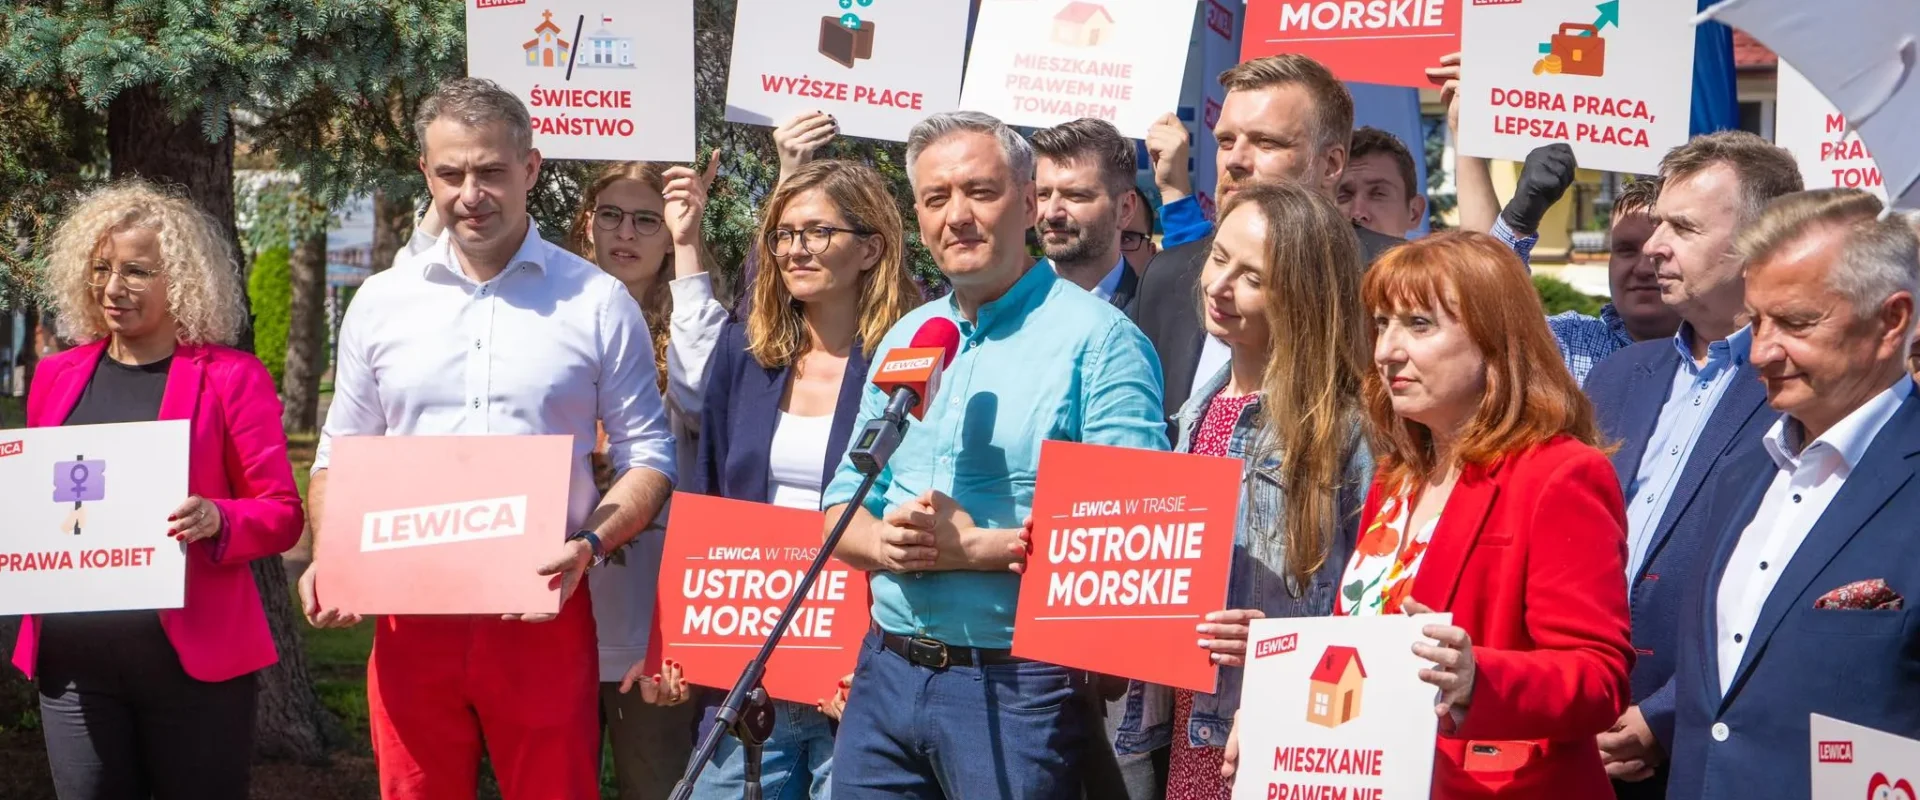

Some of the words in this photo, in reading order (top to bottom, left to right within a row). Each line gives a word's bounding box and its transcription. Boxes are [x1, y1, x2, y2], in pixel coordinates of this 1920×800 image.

[1279, 0, 1446, 31] MORSKIE
[1013, 52, 1133, 79] MIESZKANIE
[530, 84, 632, 109] ŚWIECKIE
[761, 74, 848, 101] WYŻSZE
[853, 85, 923, 110] PŁACE
[1005, 73, 1095, 97] PRAWEM
[1099, 84, 1133, 101] NIE
[1012, 95, 1117, 121] TOWAREM
[1490, 87, 1567, 113] DOBRA
[1572, 95, 1656, 124] PRACA,
[529, 113, 635, 137] PAŃSTWO
[1494, 115, 1570, 140] LEPSZA
[1576, 124, 1650, 148] PŁACA
[886, 359, 929, 370] LEWICA
[1071, 500, 1122, 518] LEWICA
[1124, 499, 1140, 514] W
[1143, 496, 1186, 514] TRASIE
[372, 503, 517, 544] LEWICA
[708, 547, 761, 561] LEWICA
[765, 548, 781, 560] W
[783, 547, 823, 561] TRAS
[1048, 522, 1205, 564] USTRONIE
[0, 550, 74, 572] PRAWA
[79, 547, 156, 569] KOBIET
[682, 568, 849, 601] USTRONIE
[1047, 568, 1192, 607] MORSKIE
[682, 605, 836, 638] MORSKIE
[1258, 636, 1295, 656] LEWICA
[1273, 746, 1384, 776] MIESZKANIE
[1820, 743, 1852, 760] LEWICA
